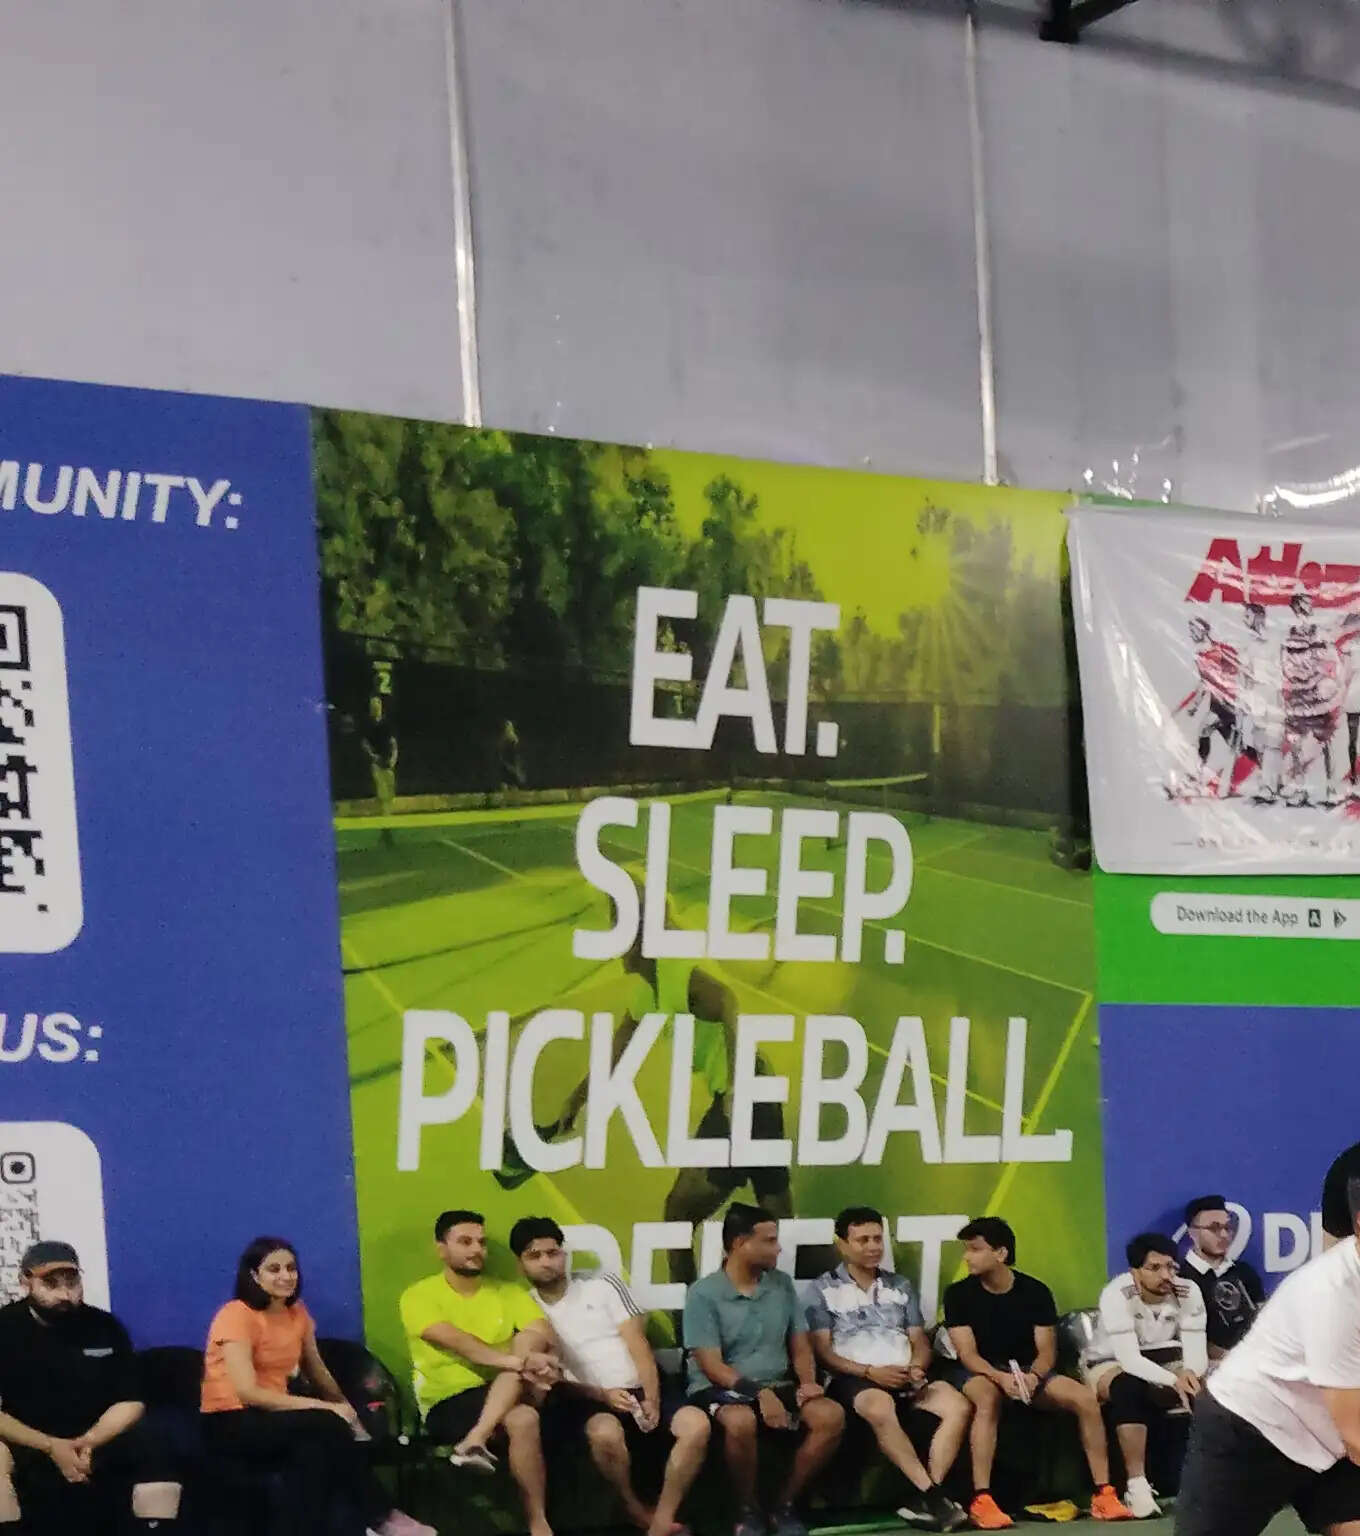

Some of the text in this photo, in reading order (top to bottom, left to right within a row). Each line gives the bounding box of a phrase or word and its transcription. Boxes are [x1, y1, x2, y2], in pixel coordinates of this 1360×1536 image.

[629, 586, 841, 758] EAT.
[571, 797, 914, 964] SLEEP.
[1176, 905, 1298, 928] Download the App
[0, 1012, 103, 1063] US:
